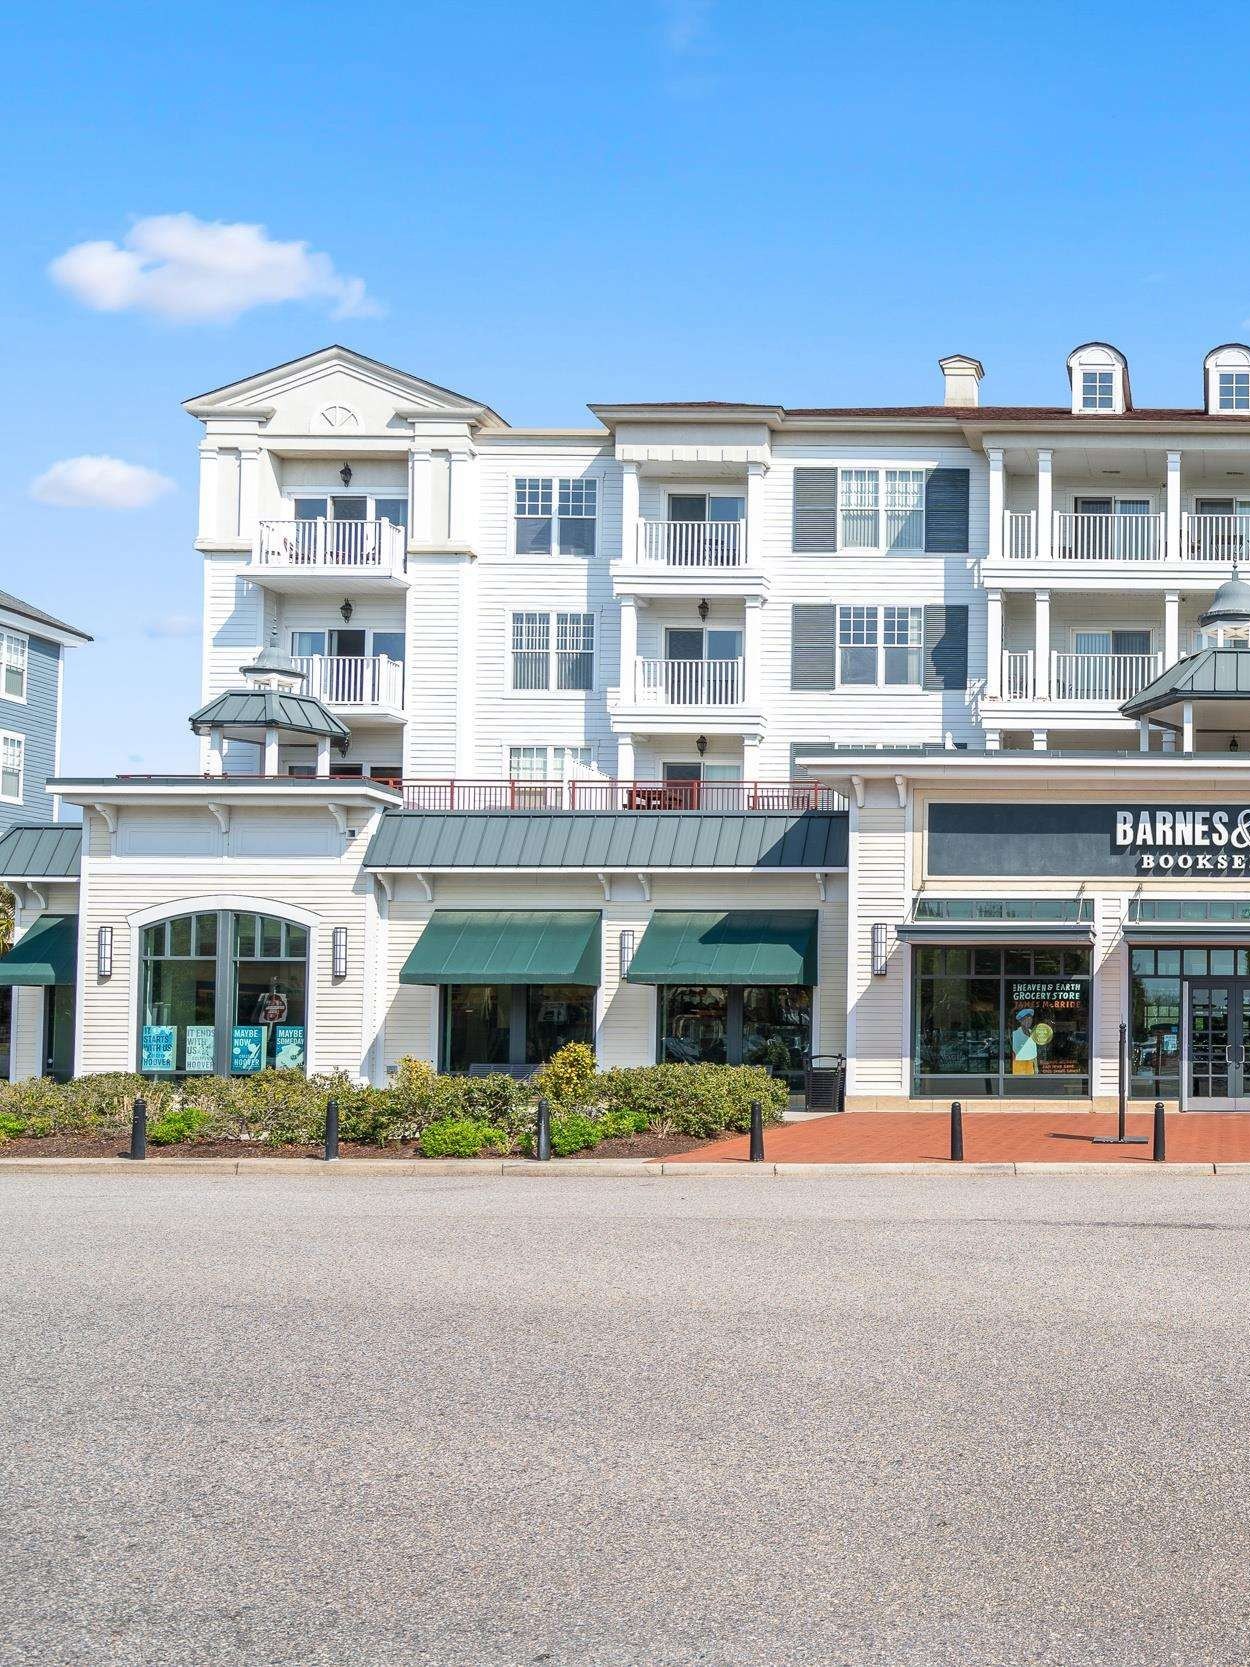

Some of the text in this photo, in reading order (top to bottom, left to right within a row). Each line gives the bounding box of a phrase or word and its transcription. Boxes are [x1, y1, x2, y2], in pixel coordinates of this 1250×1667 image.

[1017, 983, 1047, 992] HEAVEN
[1055, 983, 1081, 991] EARTH
[1013, 991, 1081, 1001] GROCERY STORE
[1013, 1000, 1041, 1008] JAMES
[196, 1028, 215, 1038] ENDS
[233, 1029, 259, 1038] MAYBE
[277, 1029, 304, 1038] MAYBE
[143, 1035, 169, 1044] STARTS
[187, 1037, 207, 1046] WITH
[233, 1038, 251, 1047] NOW
[276, 1037, 304, 1045] SOMEDAY
[143, 1043, 173, 1052] WITH US
[187, 1046, 198, 1055] US
[143, 1058, 171, 1067] HOOVER
[233, 1058, 260, 1067] HOOVER
